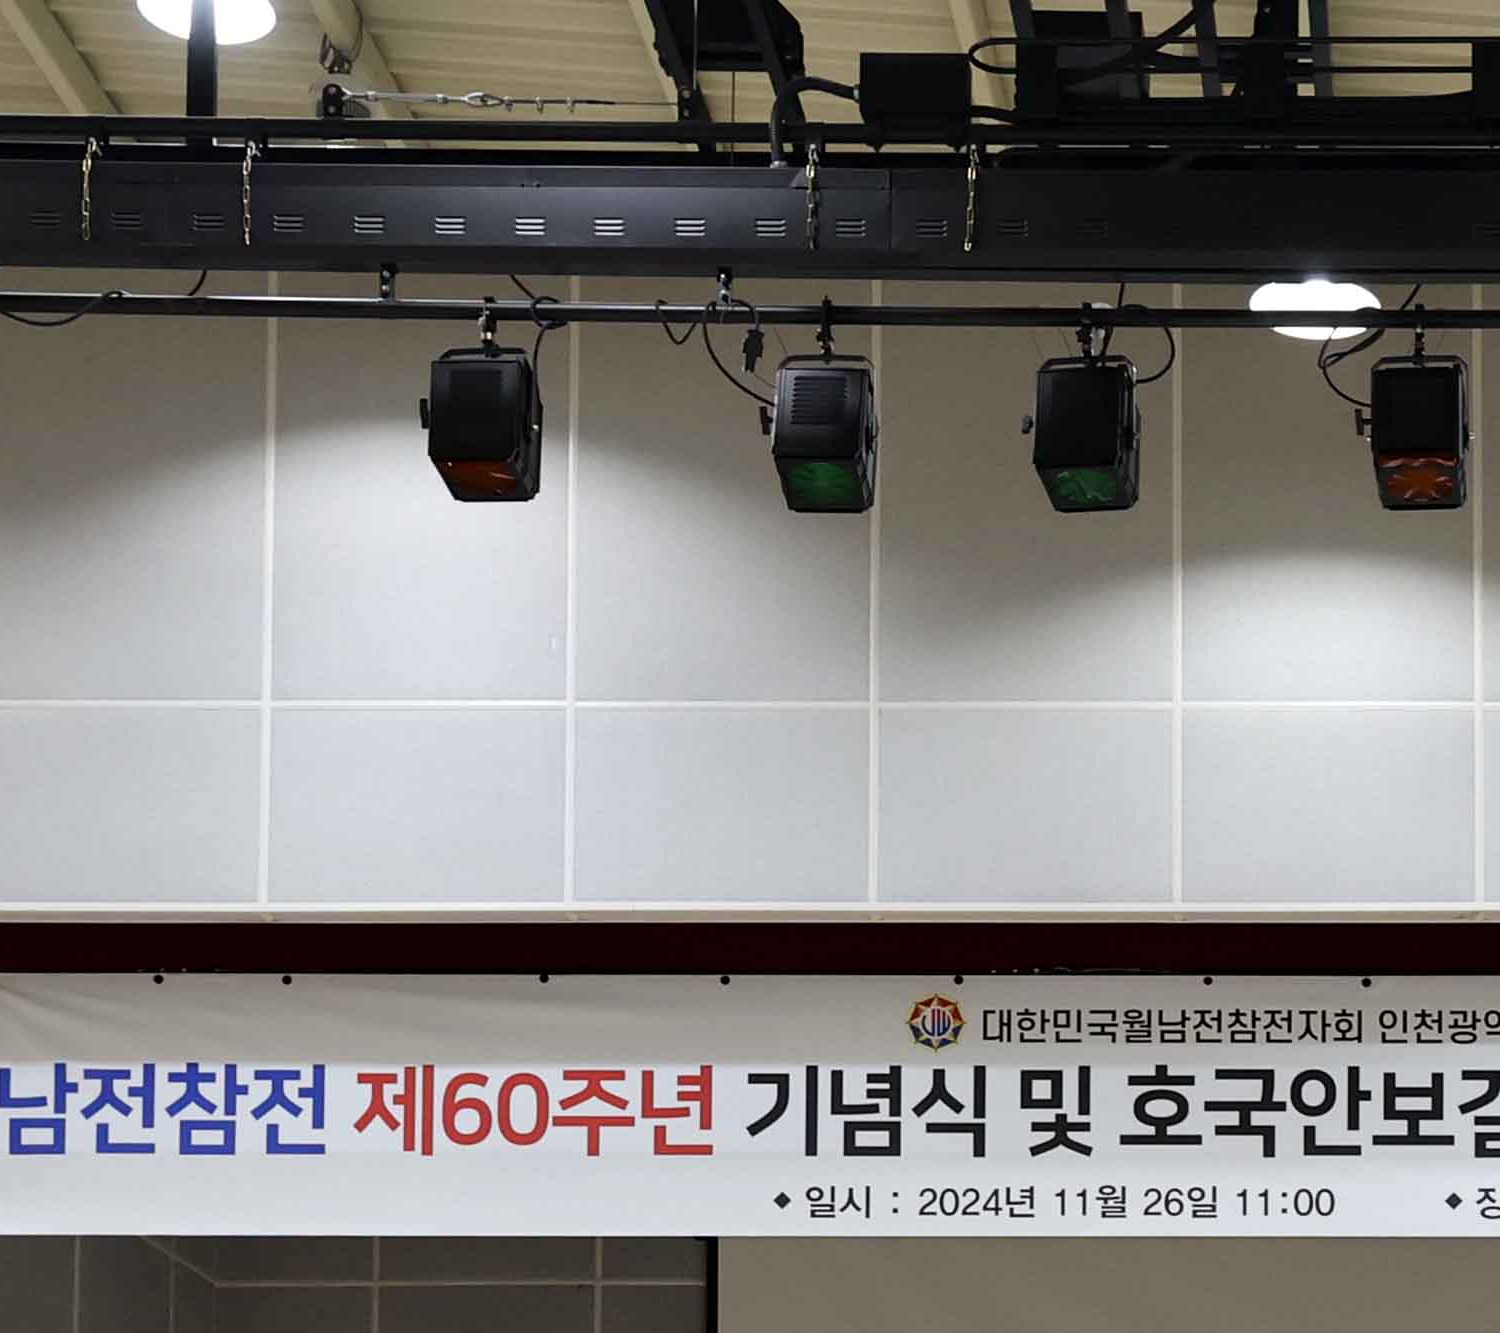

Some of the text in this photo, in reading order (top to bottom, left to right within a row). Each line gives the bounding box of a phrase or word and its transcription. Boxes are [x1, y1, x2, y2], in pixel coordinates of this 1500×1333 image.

[982, 1007, 1363, 1044] 대한민국월남전참전자회
[355, 1063, 714, 1157] 제60주년
[746, 1064, 987, 1158] 기념식
[1019, 1065, 1093, 1157] 및
[805, 1185, 871, 1219] 일시
[918, 1185, 1035, 1218] 2024년
[1055, 1184, 1127, 1219] 11월
[1143, 1185, 1218, 1219] 26일
[1237, 1188, 1335, 1217] 11:00
